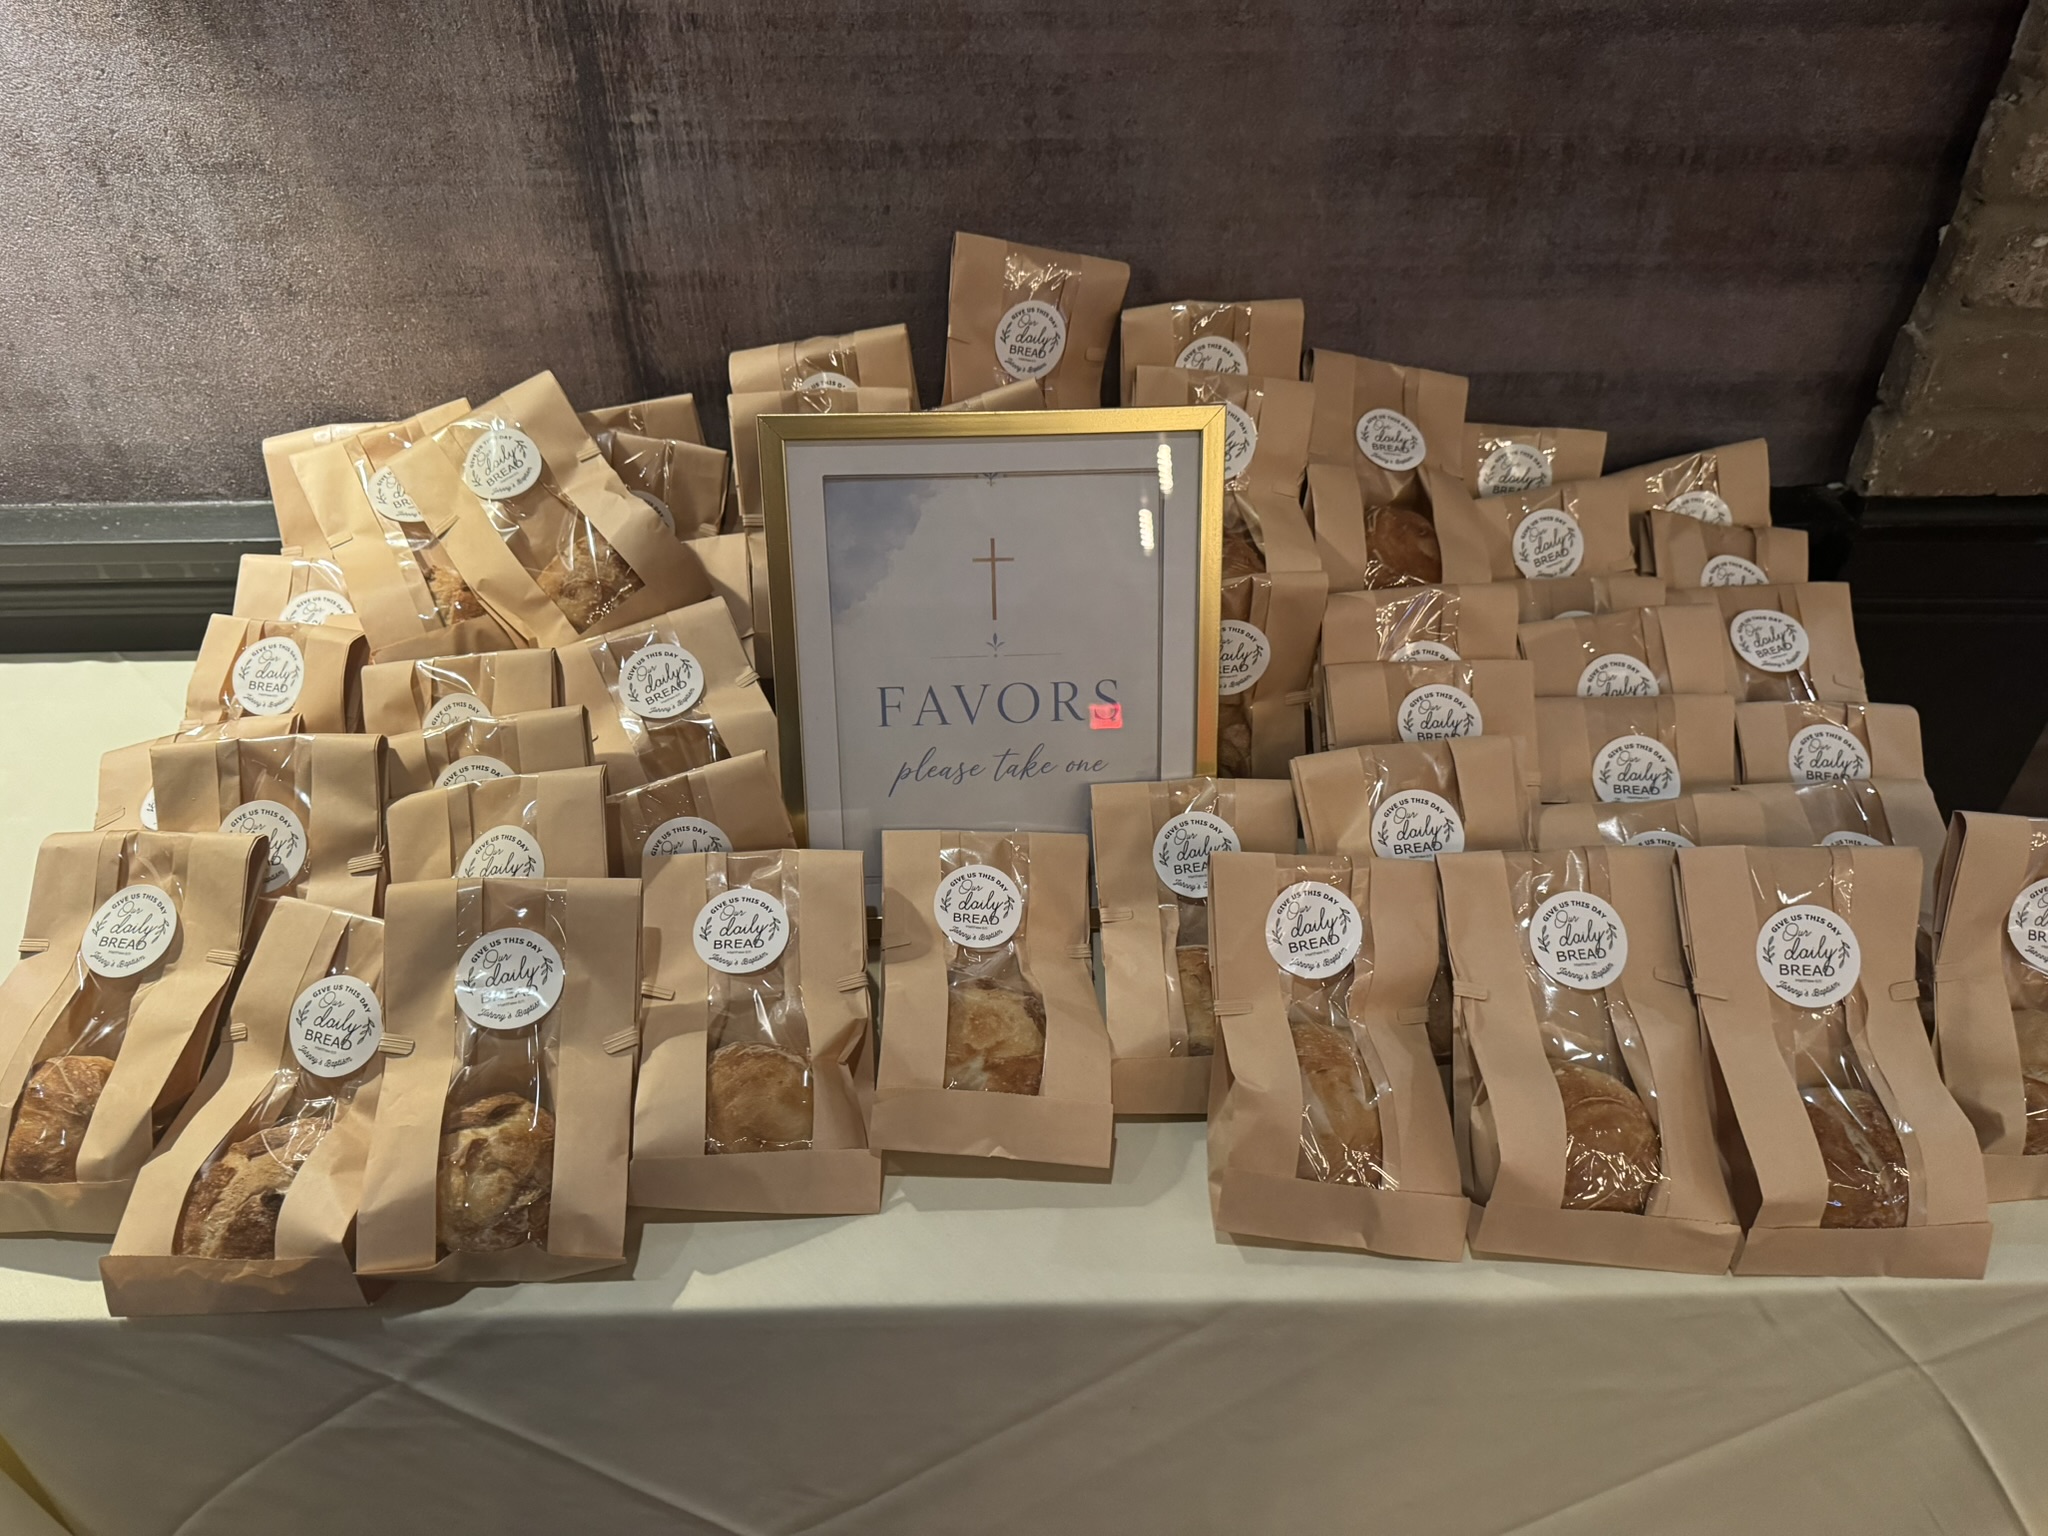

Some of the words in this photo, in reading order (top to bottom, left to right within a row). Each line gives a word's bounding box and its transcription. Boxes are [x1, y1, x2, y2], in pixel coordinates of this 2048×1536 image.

[1009, 345, 1046, 358] BREAD
[1373, 443, 1408, 454] BREAD
[486, 458, 523, 486] BREAD
[1534, 547, 1569, 568] BREAD
[1246, 633, 1257, 642] DAY
[252, 645, 266, 656] GIVE
[278, 645, 291, 653] THIS
[1755, 642, 1792, 658] BREAD
[626, 666, 637, 681] GIVE
[635, 657, 646, 666] US
[645, 651, 663, 659] THIS
[248, 681, 288, 692] BREAD
[646, 680, 686, 705] BREAD
[877, 679, 1118, 727] FAVORS
[1409, 695, 1424, 708] GIVE
[1436, 692, 1453, 700] THIS
[1454, 699, 1466, 709] DAY
[1800, 734, 1814, 746] GIVE
[1826, 732, 1842, 741] THIS
[1843, 740, 1856, 751] DAY
[1608, 746, 1623, 759] GIVE
[1636, 744, 1653, 752] THIS
[1654, 751, 1666, 763] DAY
[1617, 751, 1641, 766] Our
[888, 746, 986, 797] please
[993, 743, 1058, 782] take
[1065, 757, 1109, 774] one
[1618, 762, 1662, 792] daily
[1614, 784, 1659, 795] BREAD
[230, 813, 247, 827] GIVE
[261, 809, 279, 818] THIS
[279, 816, 292, 829] DAY
[1383, 803, 1398, 818] GIVE
[1431, 803, 1445, 814] DAY
[1394, 807, 1419, 824] Our
[672, 826, 690, 834] THIS
[693, 827, 708, 835] DAY
[1164, 825, 1178, 840] GIVE
[1210, 824, 1223, 835] DAY
[1174, 829, 1198, 845] Our
[1397, 815, 1442, 848] daily
[475, 840, 489, 855] GIVE
[517, 840, 528, 852] DAY
[1394, 841, 1442, 855] BREAD
[1174, 860, 1208, 875] BREA
[950, 875, 965, 887] GIVE
[979, 873, 996, 881] THIS
[996, 881, 1008, 892] DAY
[958, 879, 983, 894] Our
[111, 897, 128, 909] GIVE
[144, 894, 160, 904] THIS
[158, 903, 167, 915] DAY
[117, 901, 143, 917] Our
[710, 901, 727, 915] GIVE
[761, 903, 774, 914] DAY
[719, 905, 747, 921] Our
[958, 891, 1003, 922] daily
[1276, 899, 1290, 915] GIVE
[1291, 893, 1301, 901] US
[1324, 894, 1339, 905] DAY
[1287, 902, 1312, 920] Our
[1543, 906, 1558, 922] GIVE
[1558, 901, 1569, 909] US
[1571, 901, 1590, 909] THIS
[1592, 907, 1606, 919] DAY
[953, 913, 999, 925] BREAD
[1291, 907, 1338, 942] daily
[1554, 910, 1580, 929] Our
[1771, 918, 1789, 933] GIVE
[1805, 914, 1826, 924] THIS
[1827, 923, 1842, 936] DAY
[110, 913, 157, 947] daily
[719, 914, 768, 945] daily
[1559, 919, 1605, 955] daily
[1783, 923, 1812, 941] Our
[98, 937, 146, 950] BREAD
[471, 946, 488, 964] GIVE
[489, 940, 502, 949] US
[527, 941, 543, 954] DAY
[714, 938, 764, 949] BREAD
[1289, 934, 1339, 953] BREAD
[482, 950, 513, 969] Our
[1557, 947, 1607, 963] BREAD
[1784, 935, 1837, 973] daily
[485, 955, 539, 992] daily
[1780, 964, 1835, 976] BREAD
[312, 986, 329, 998] GIVE
[345, 986, 361, 998] THIS
[360, 998, 371, 1013] DAY
[319, 991, 346, 1009] Our
[313, 1007, 361, 1047] daily
[303, 1029, 351, 1051] BREAD
